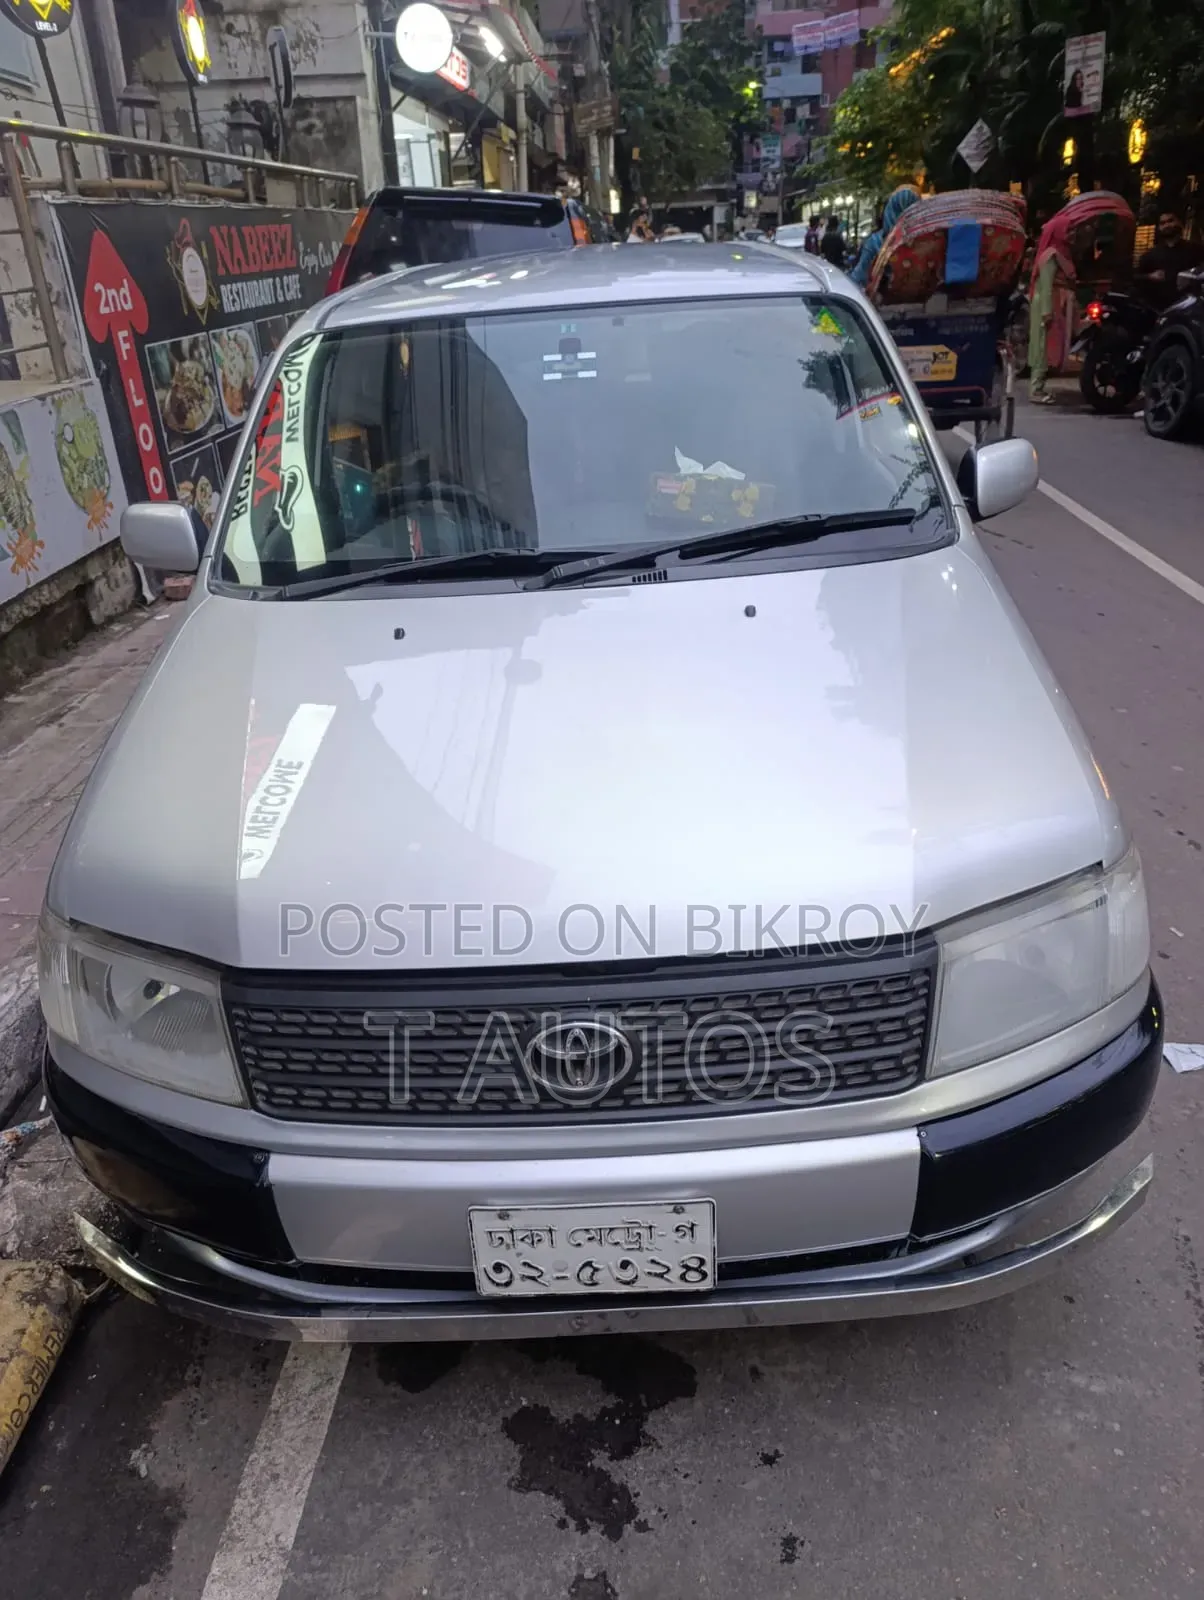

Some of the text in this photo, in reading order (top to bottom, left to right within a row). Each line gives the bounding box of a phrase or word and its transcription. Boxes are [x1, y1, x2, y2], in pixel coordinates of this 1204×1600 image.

[209, 223, 297, 276] NABEEZ
[94, 279, 133, 315] 2nd
[220, 273, 302, 314] RESTAURANT & CAFE
[117, 330, 163, 495] FLOO
[483, 1253, 710, 1289] ৩২-৫৩২৪
